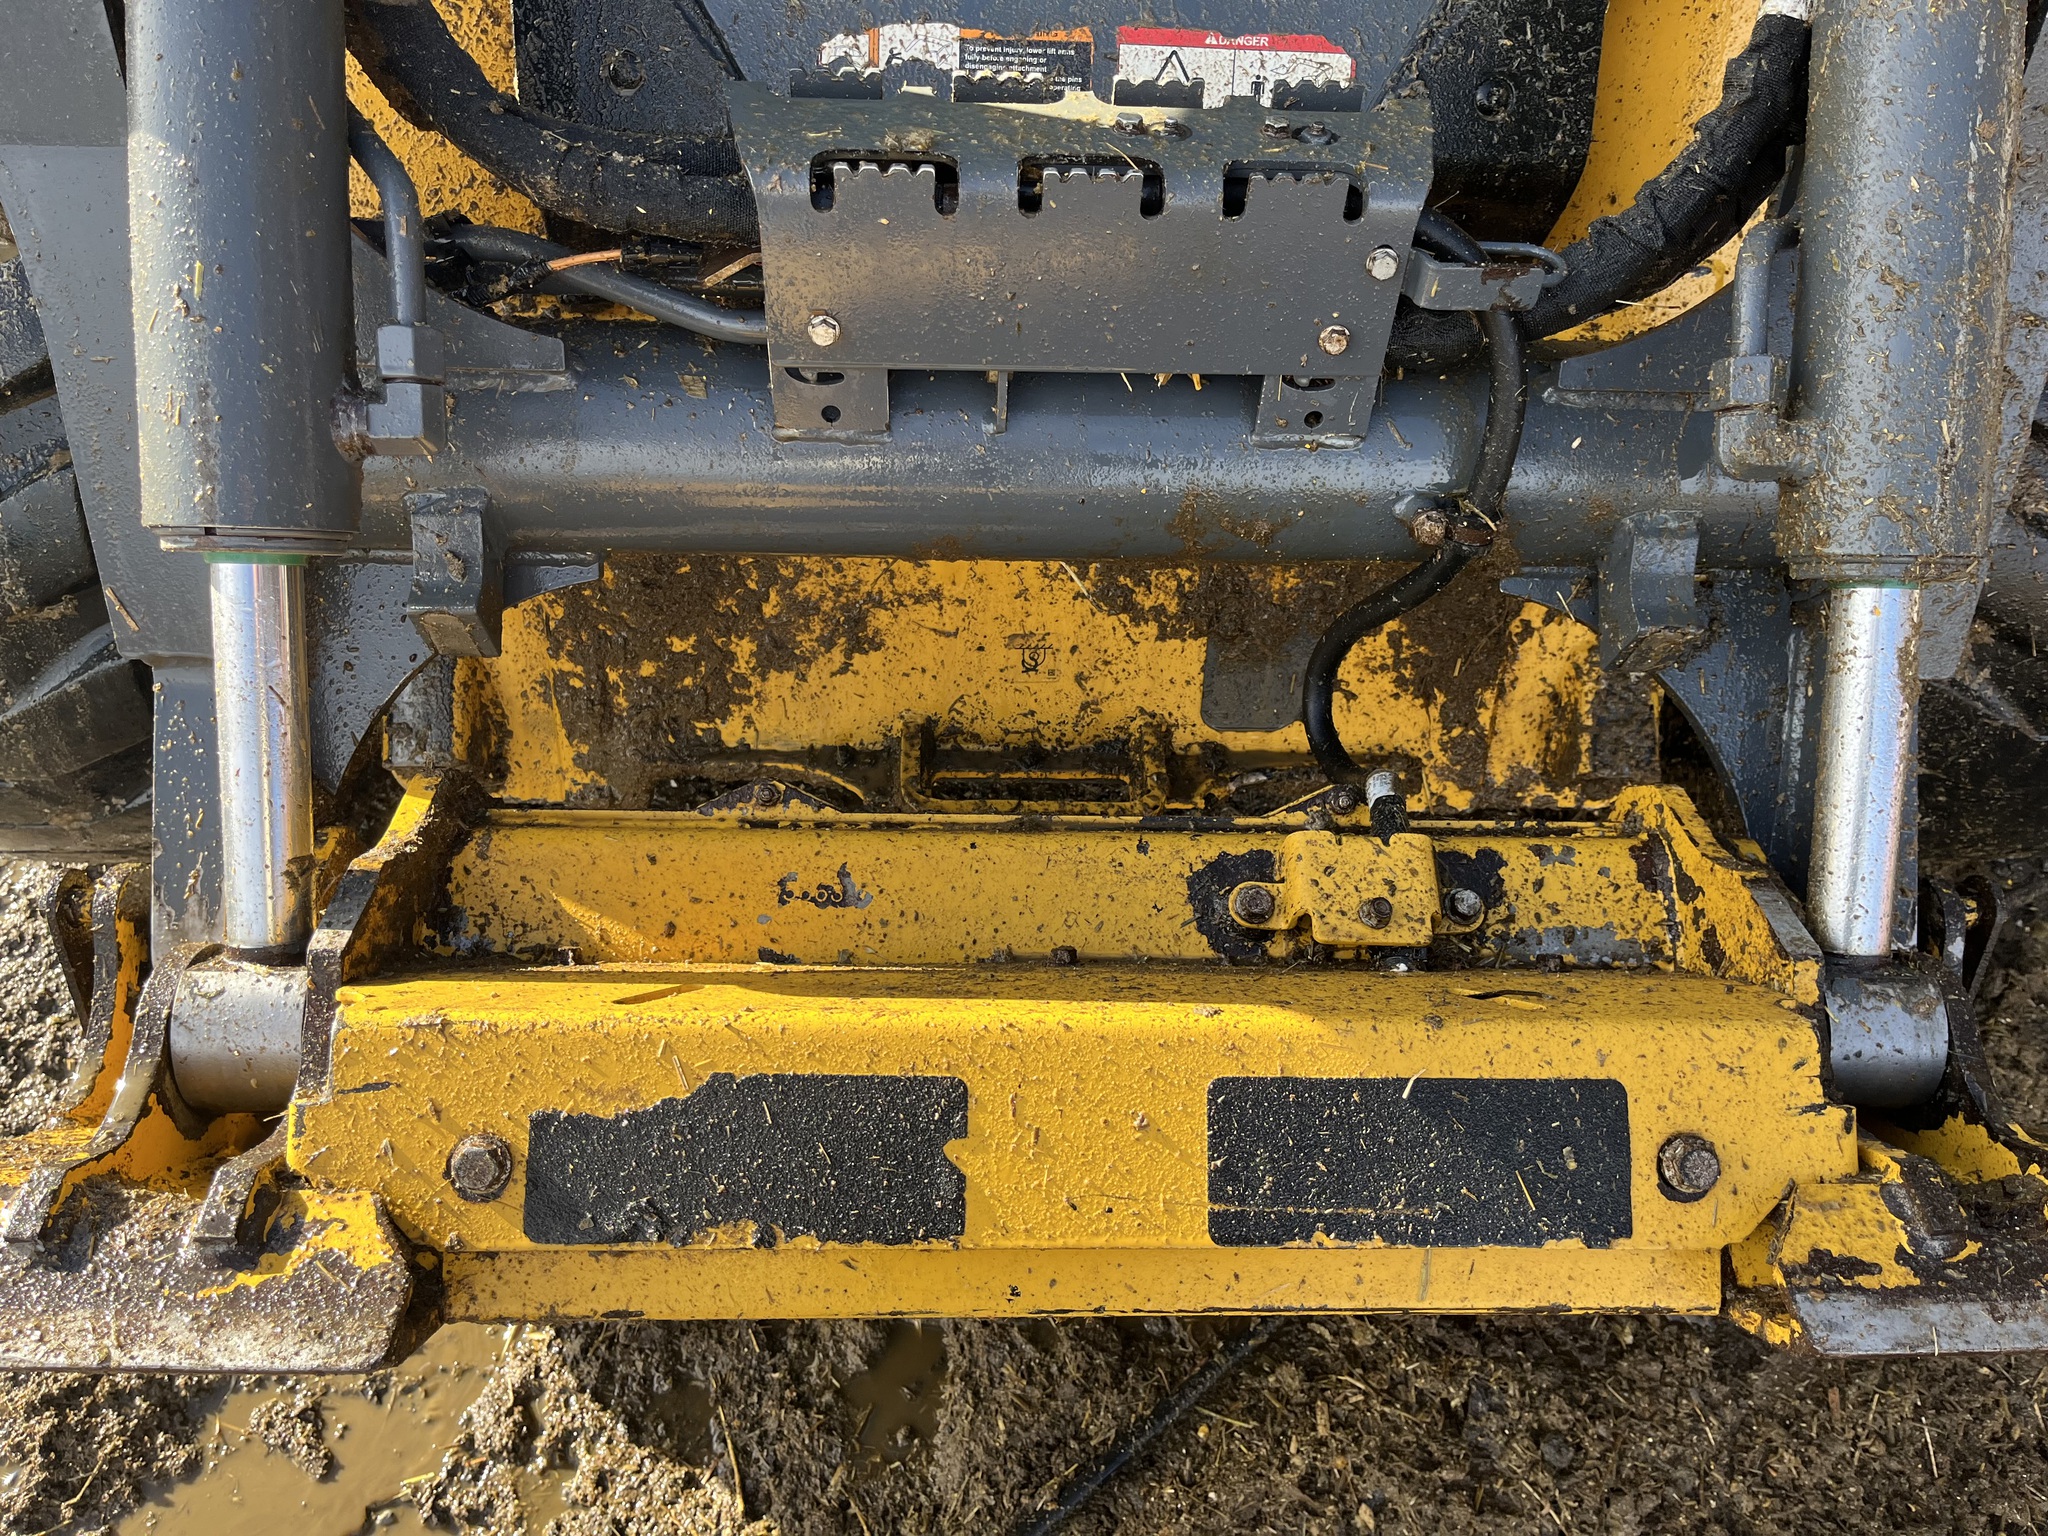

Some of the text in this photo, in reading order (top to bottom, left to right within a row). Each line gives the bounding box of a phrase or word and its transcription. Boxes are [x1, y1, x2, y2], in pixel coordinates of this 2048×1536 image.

[1218, 35, 1269, 47] DANGER
[963, 43, 974, 52] To
[975, 46, 1002, 54] prevent
[1026, 46, 1046, 54] lower
[1046, 47, 1057, 55] lift
[964, 53, 980, 62] fully
[1005, 55, 1037, 65] engging
[1008, 63, 1047, 73] attachment
[1067, 75, 1083, 84] pins
